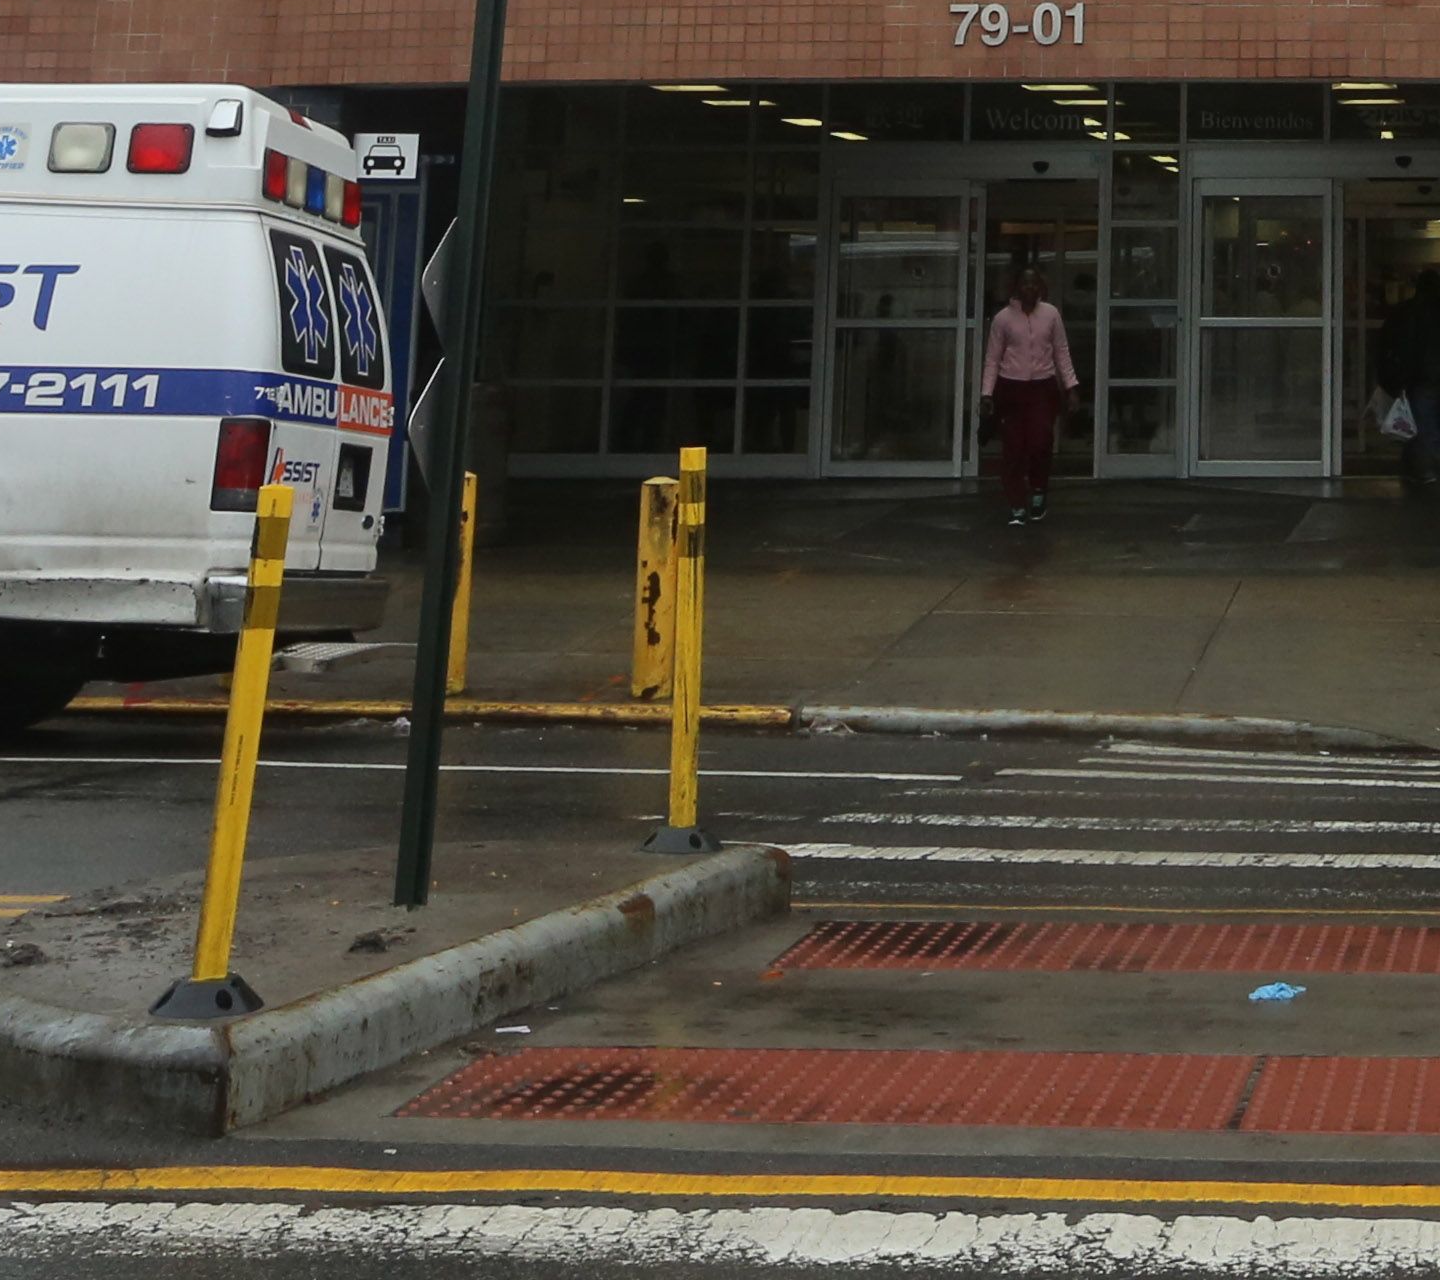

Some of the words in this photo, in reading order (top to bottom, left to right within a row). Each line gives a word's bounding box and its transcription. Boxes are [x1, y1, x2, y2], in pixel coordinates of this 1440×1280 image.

[948, 0, 1087, 46] 79-01
[1200, 109, 1315, 130] Bienvenidos
[377, 136, 396, 144] TAXI
[278, 382, 391, 429] AMBULANCE
